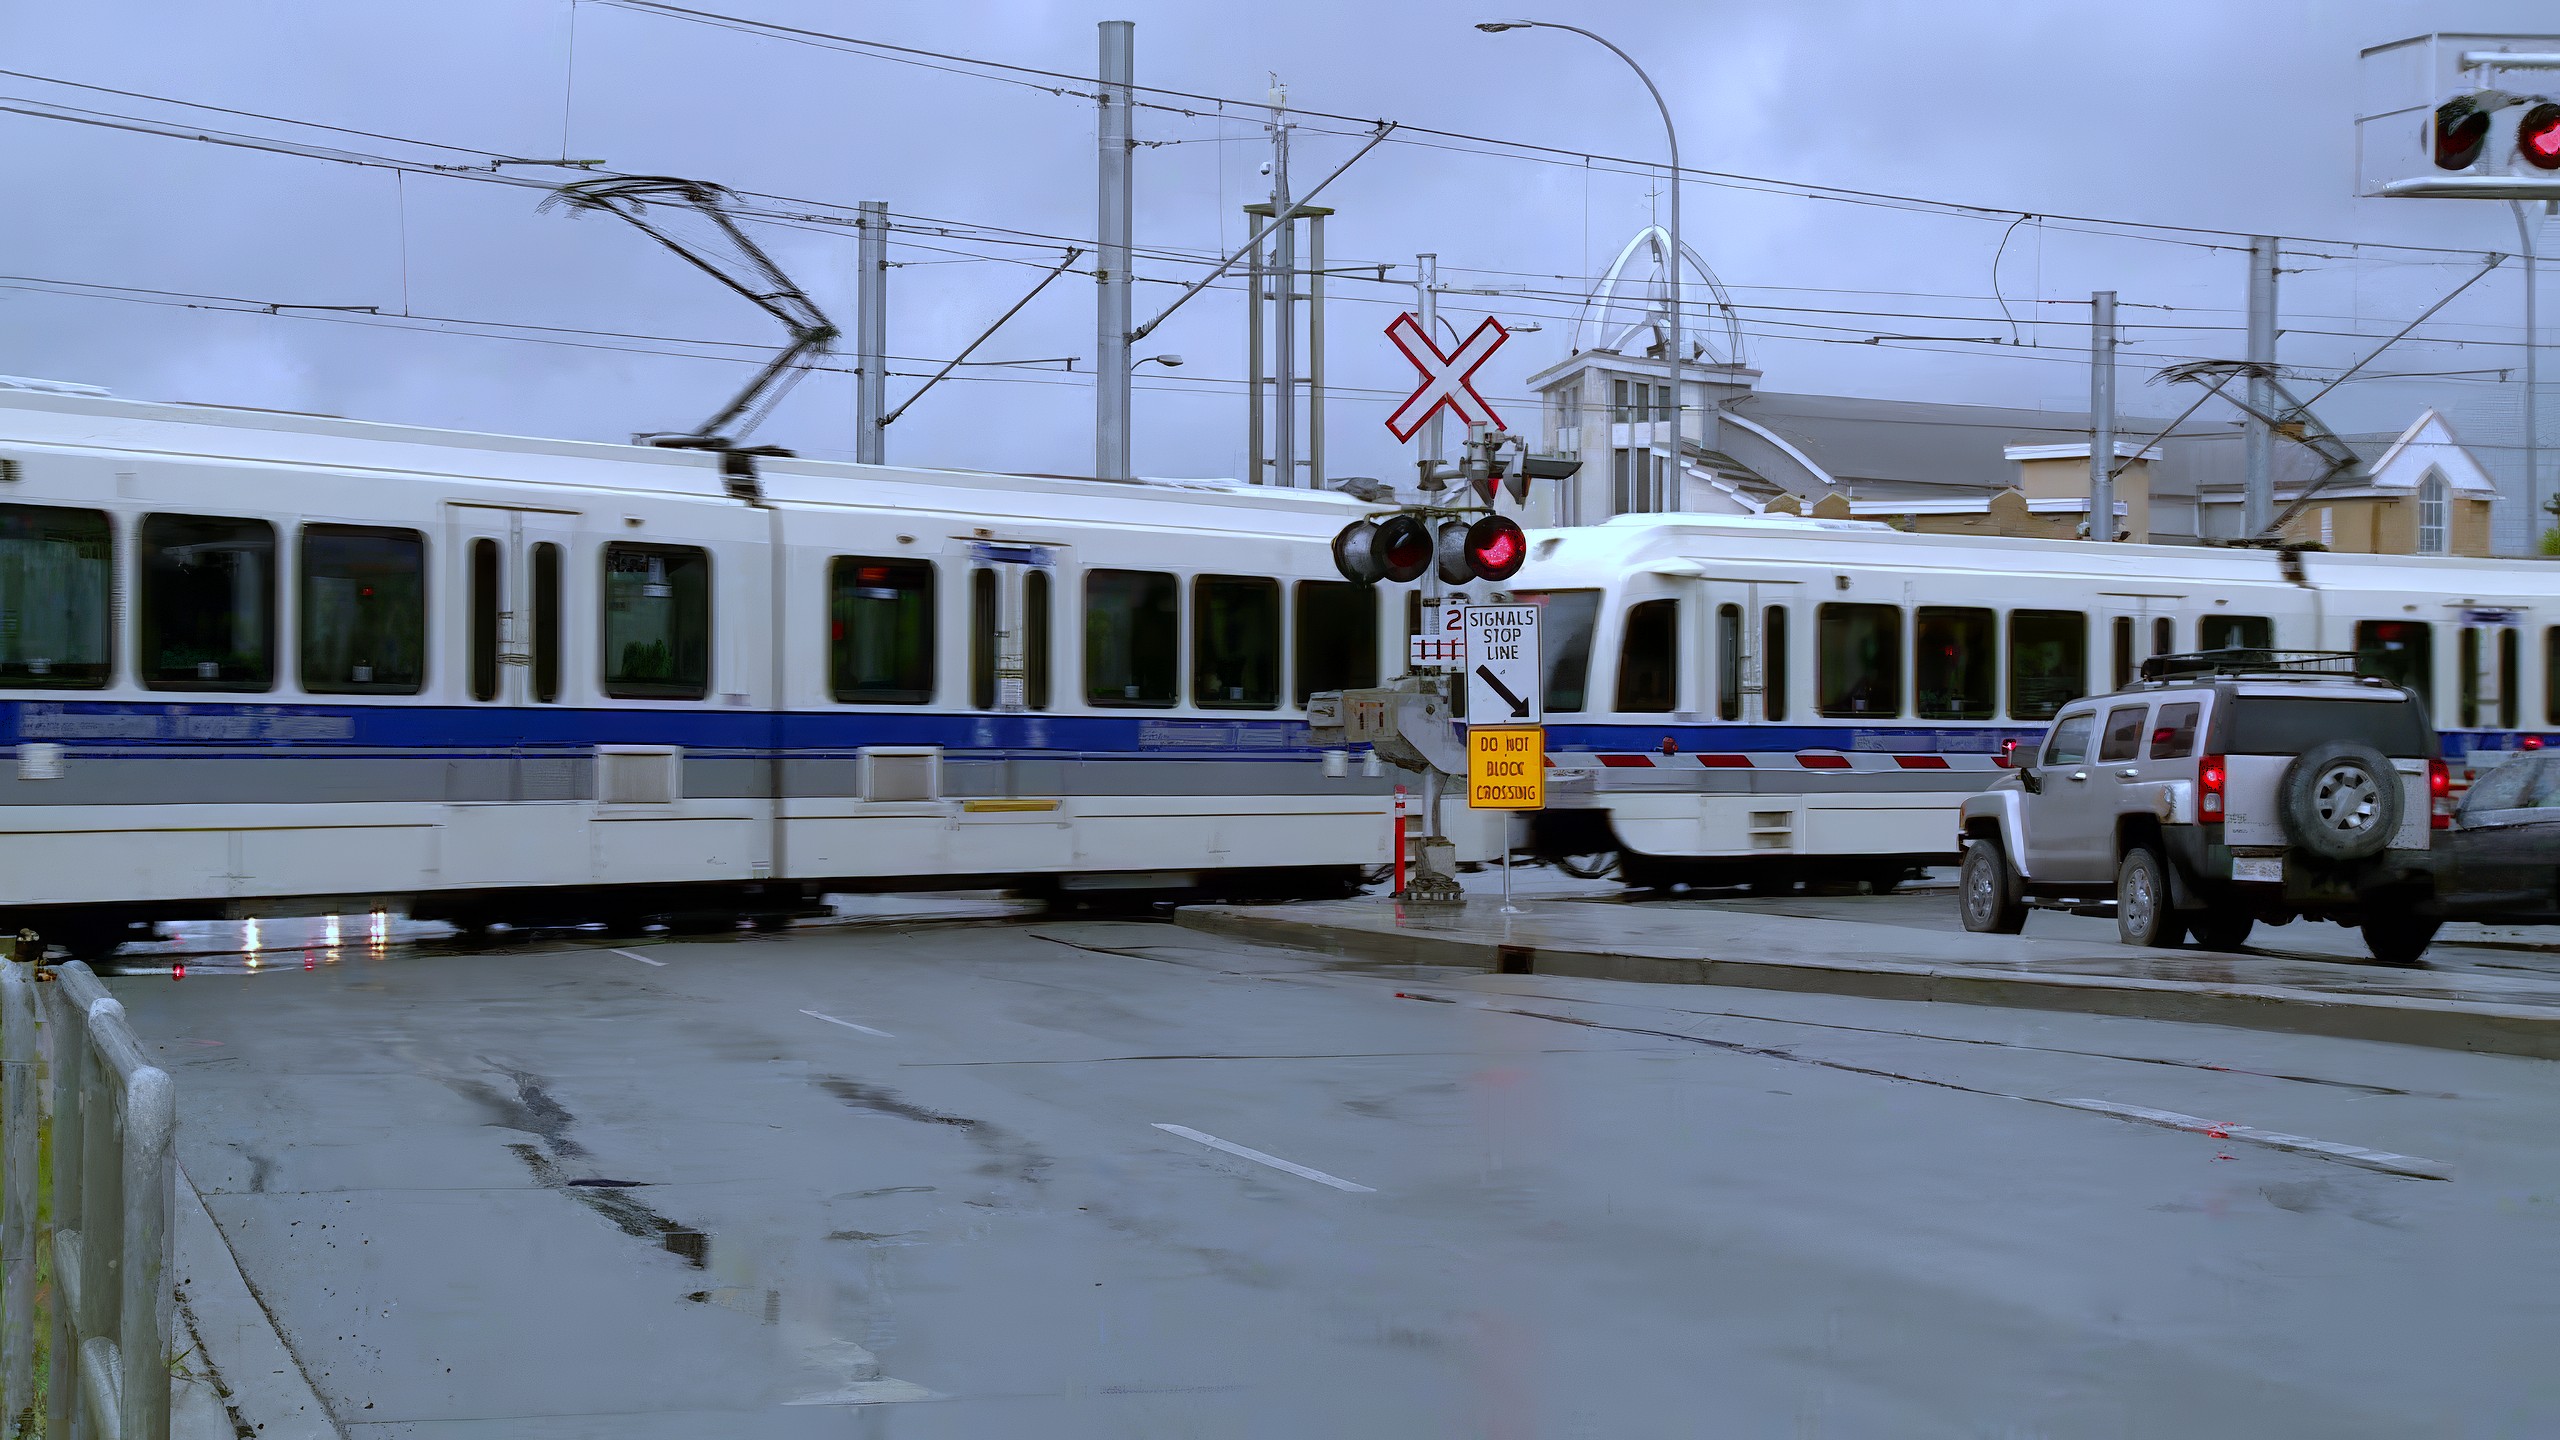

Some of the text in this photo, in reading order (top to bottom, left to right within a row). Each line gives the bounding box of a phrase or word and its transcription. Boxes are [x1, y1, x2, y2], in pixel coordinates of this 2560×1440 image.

[1446, 609, 1463, 631] 2
[1469, 609, 1534, 627] SIGNALS
[1483, 628, 1522, 644] STOP
[1487, 645, 1519, 660] LINE
[1480, 736, 1529, 752] DO NOT
[1486, 760, 1525, 777] BLOCK
